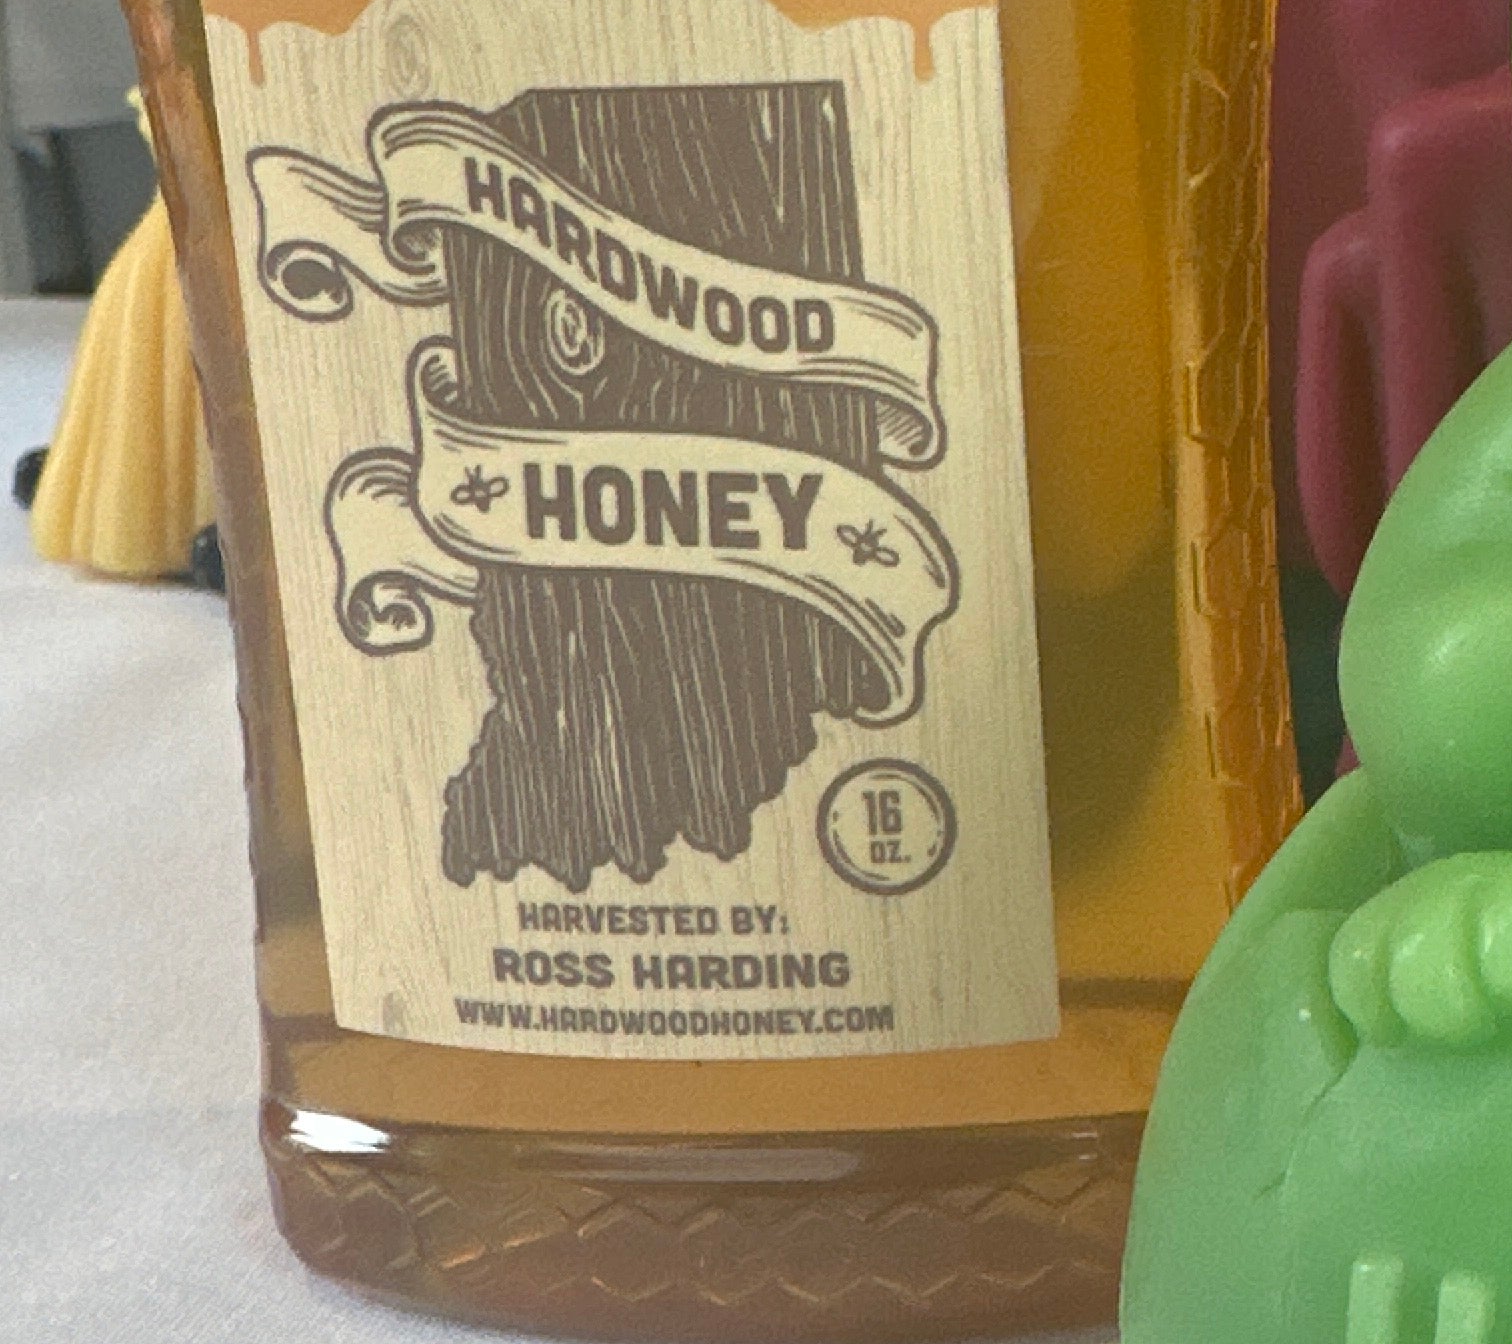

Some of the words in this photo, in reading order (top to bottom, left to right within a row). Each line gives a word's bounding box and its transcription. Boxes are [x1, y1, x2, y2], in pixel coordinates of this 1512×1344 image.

[463, 156, 834, 355] HARDWOOD
[523, 462, 823, 551] HONEY
[862, 790, 902, 835] 16
[518, 902, 719, 935] HARVESTED
[731, 906, 789, 935] BY:
[493, 949, 614, 988] ROSS
[633, 953, 850, 989] HARDING
[454, 998, 894, 1036] WWW.HARDWOODHONEY.COM
